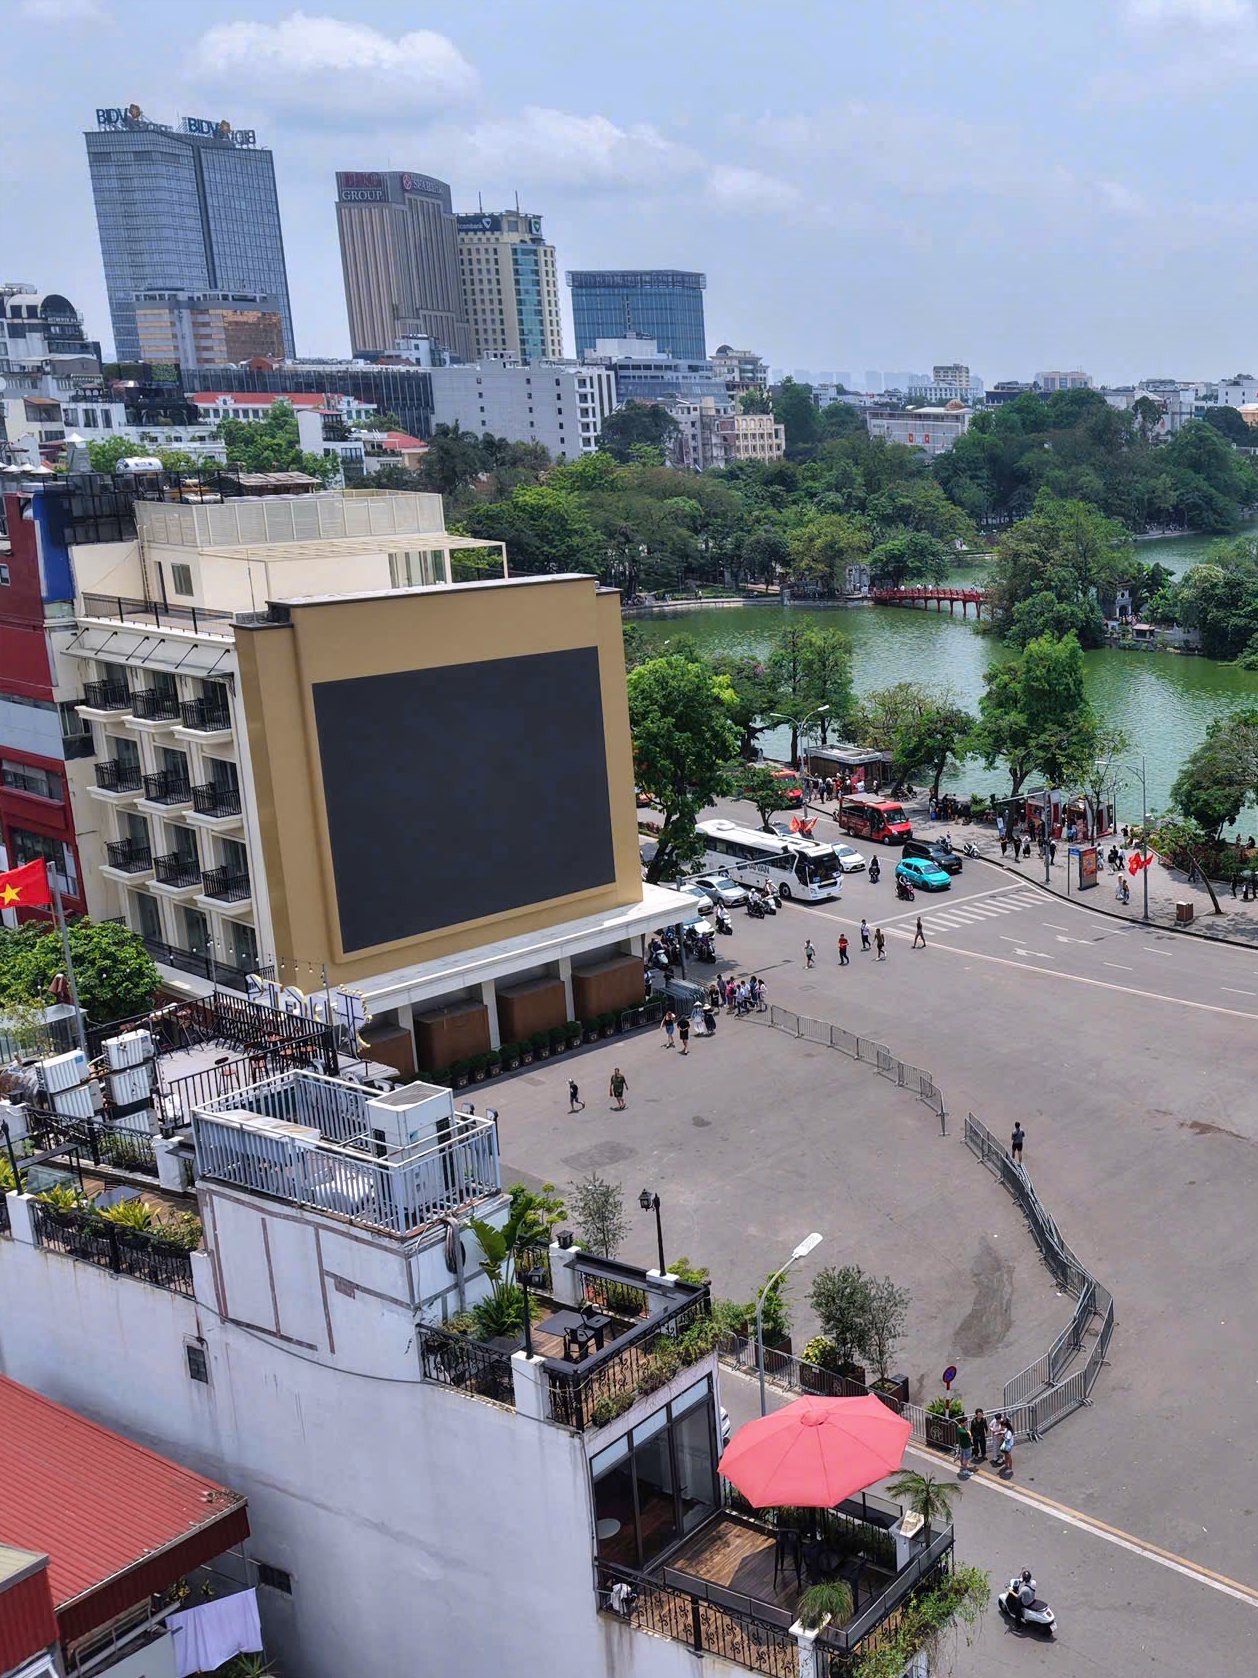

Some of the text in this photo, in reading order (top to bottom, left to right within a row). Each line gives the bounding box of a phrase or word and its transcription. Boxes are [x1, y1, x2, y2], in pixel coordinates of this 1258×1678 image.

[96, 108, 129, 124] BIDV
[187, 117, 220, 136] BIDV
[342, 190, 382, 200] GROUP
